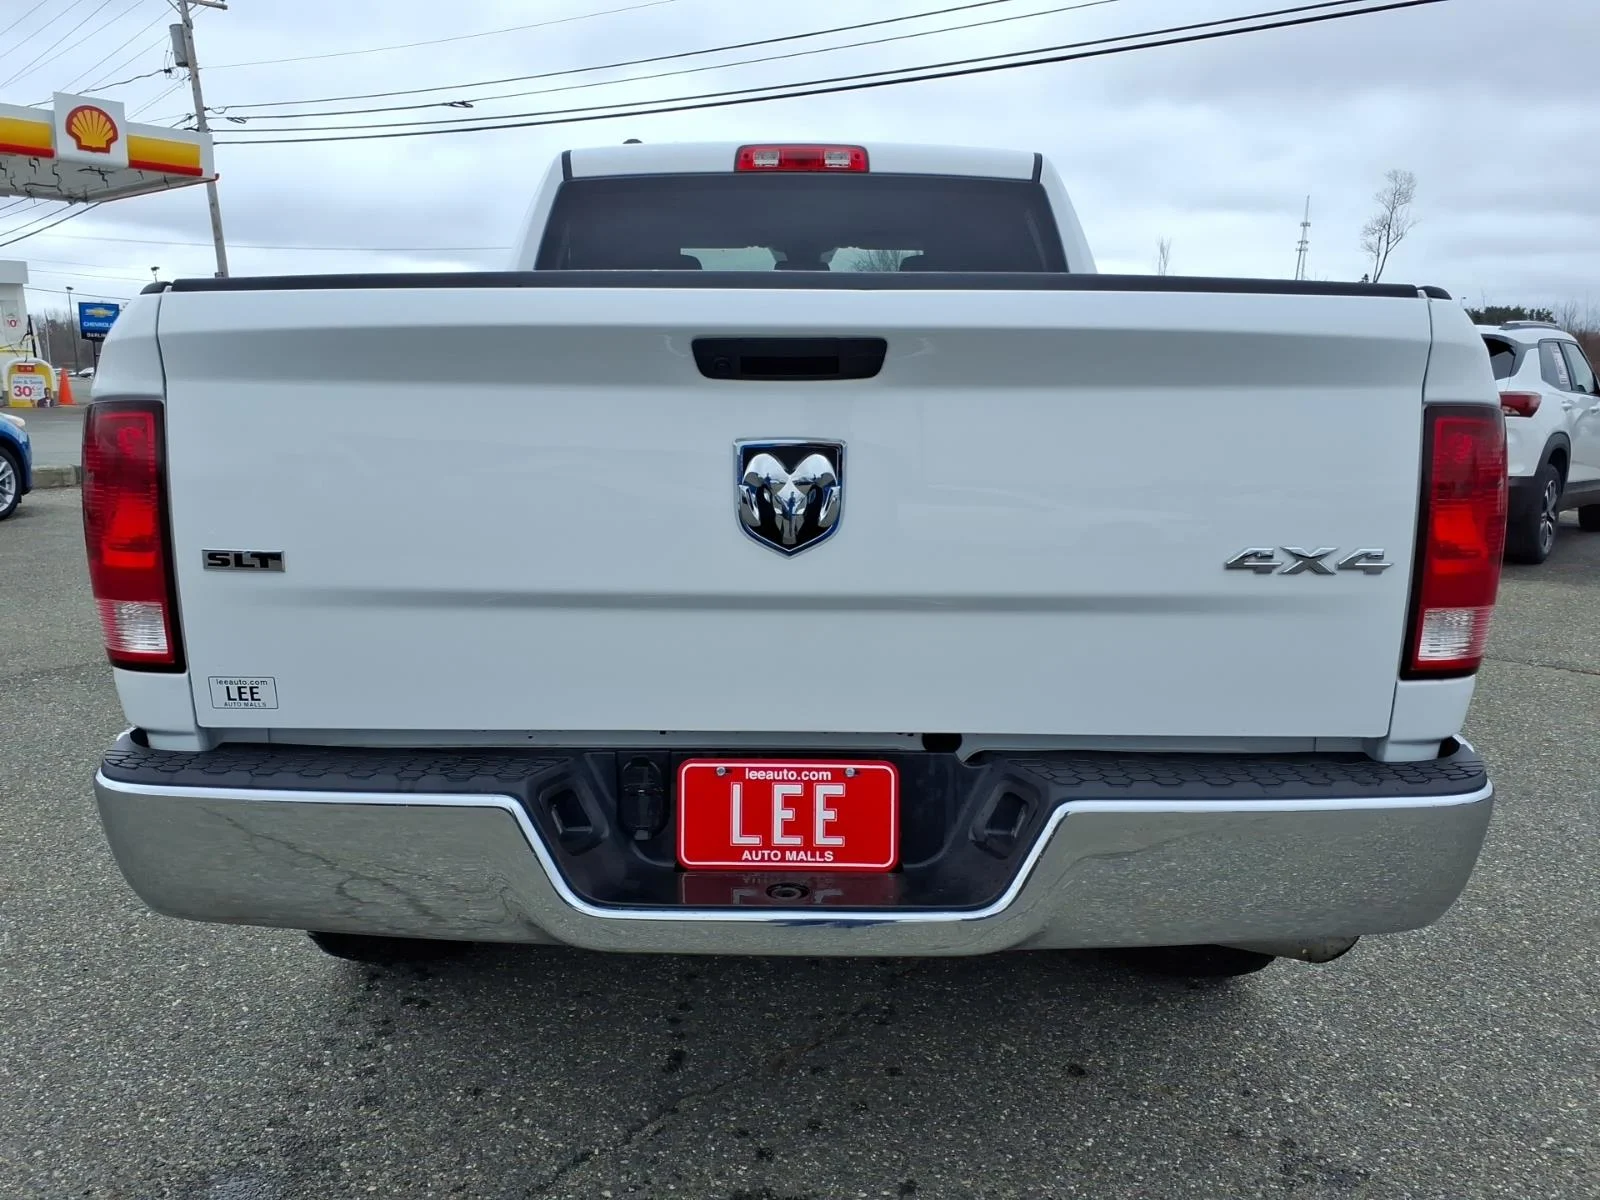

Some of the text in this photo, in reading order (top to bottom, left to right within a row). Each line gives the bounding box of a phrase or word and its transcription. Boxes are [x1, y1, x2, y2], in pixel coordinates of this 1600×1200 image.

[207, 552, 282, 569] SLT
[216, 678, 268, 686] leeauto.com
[226, 686, 261, 702] LEE
[745, 767, 832, 781] leeauto.com
[730, 782, 846, 847] LEE
[741, 850, 834, 862] AUTO MALLS
